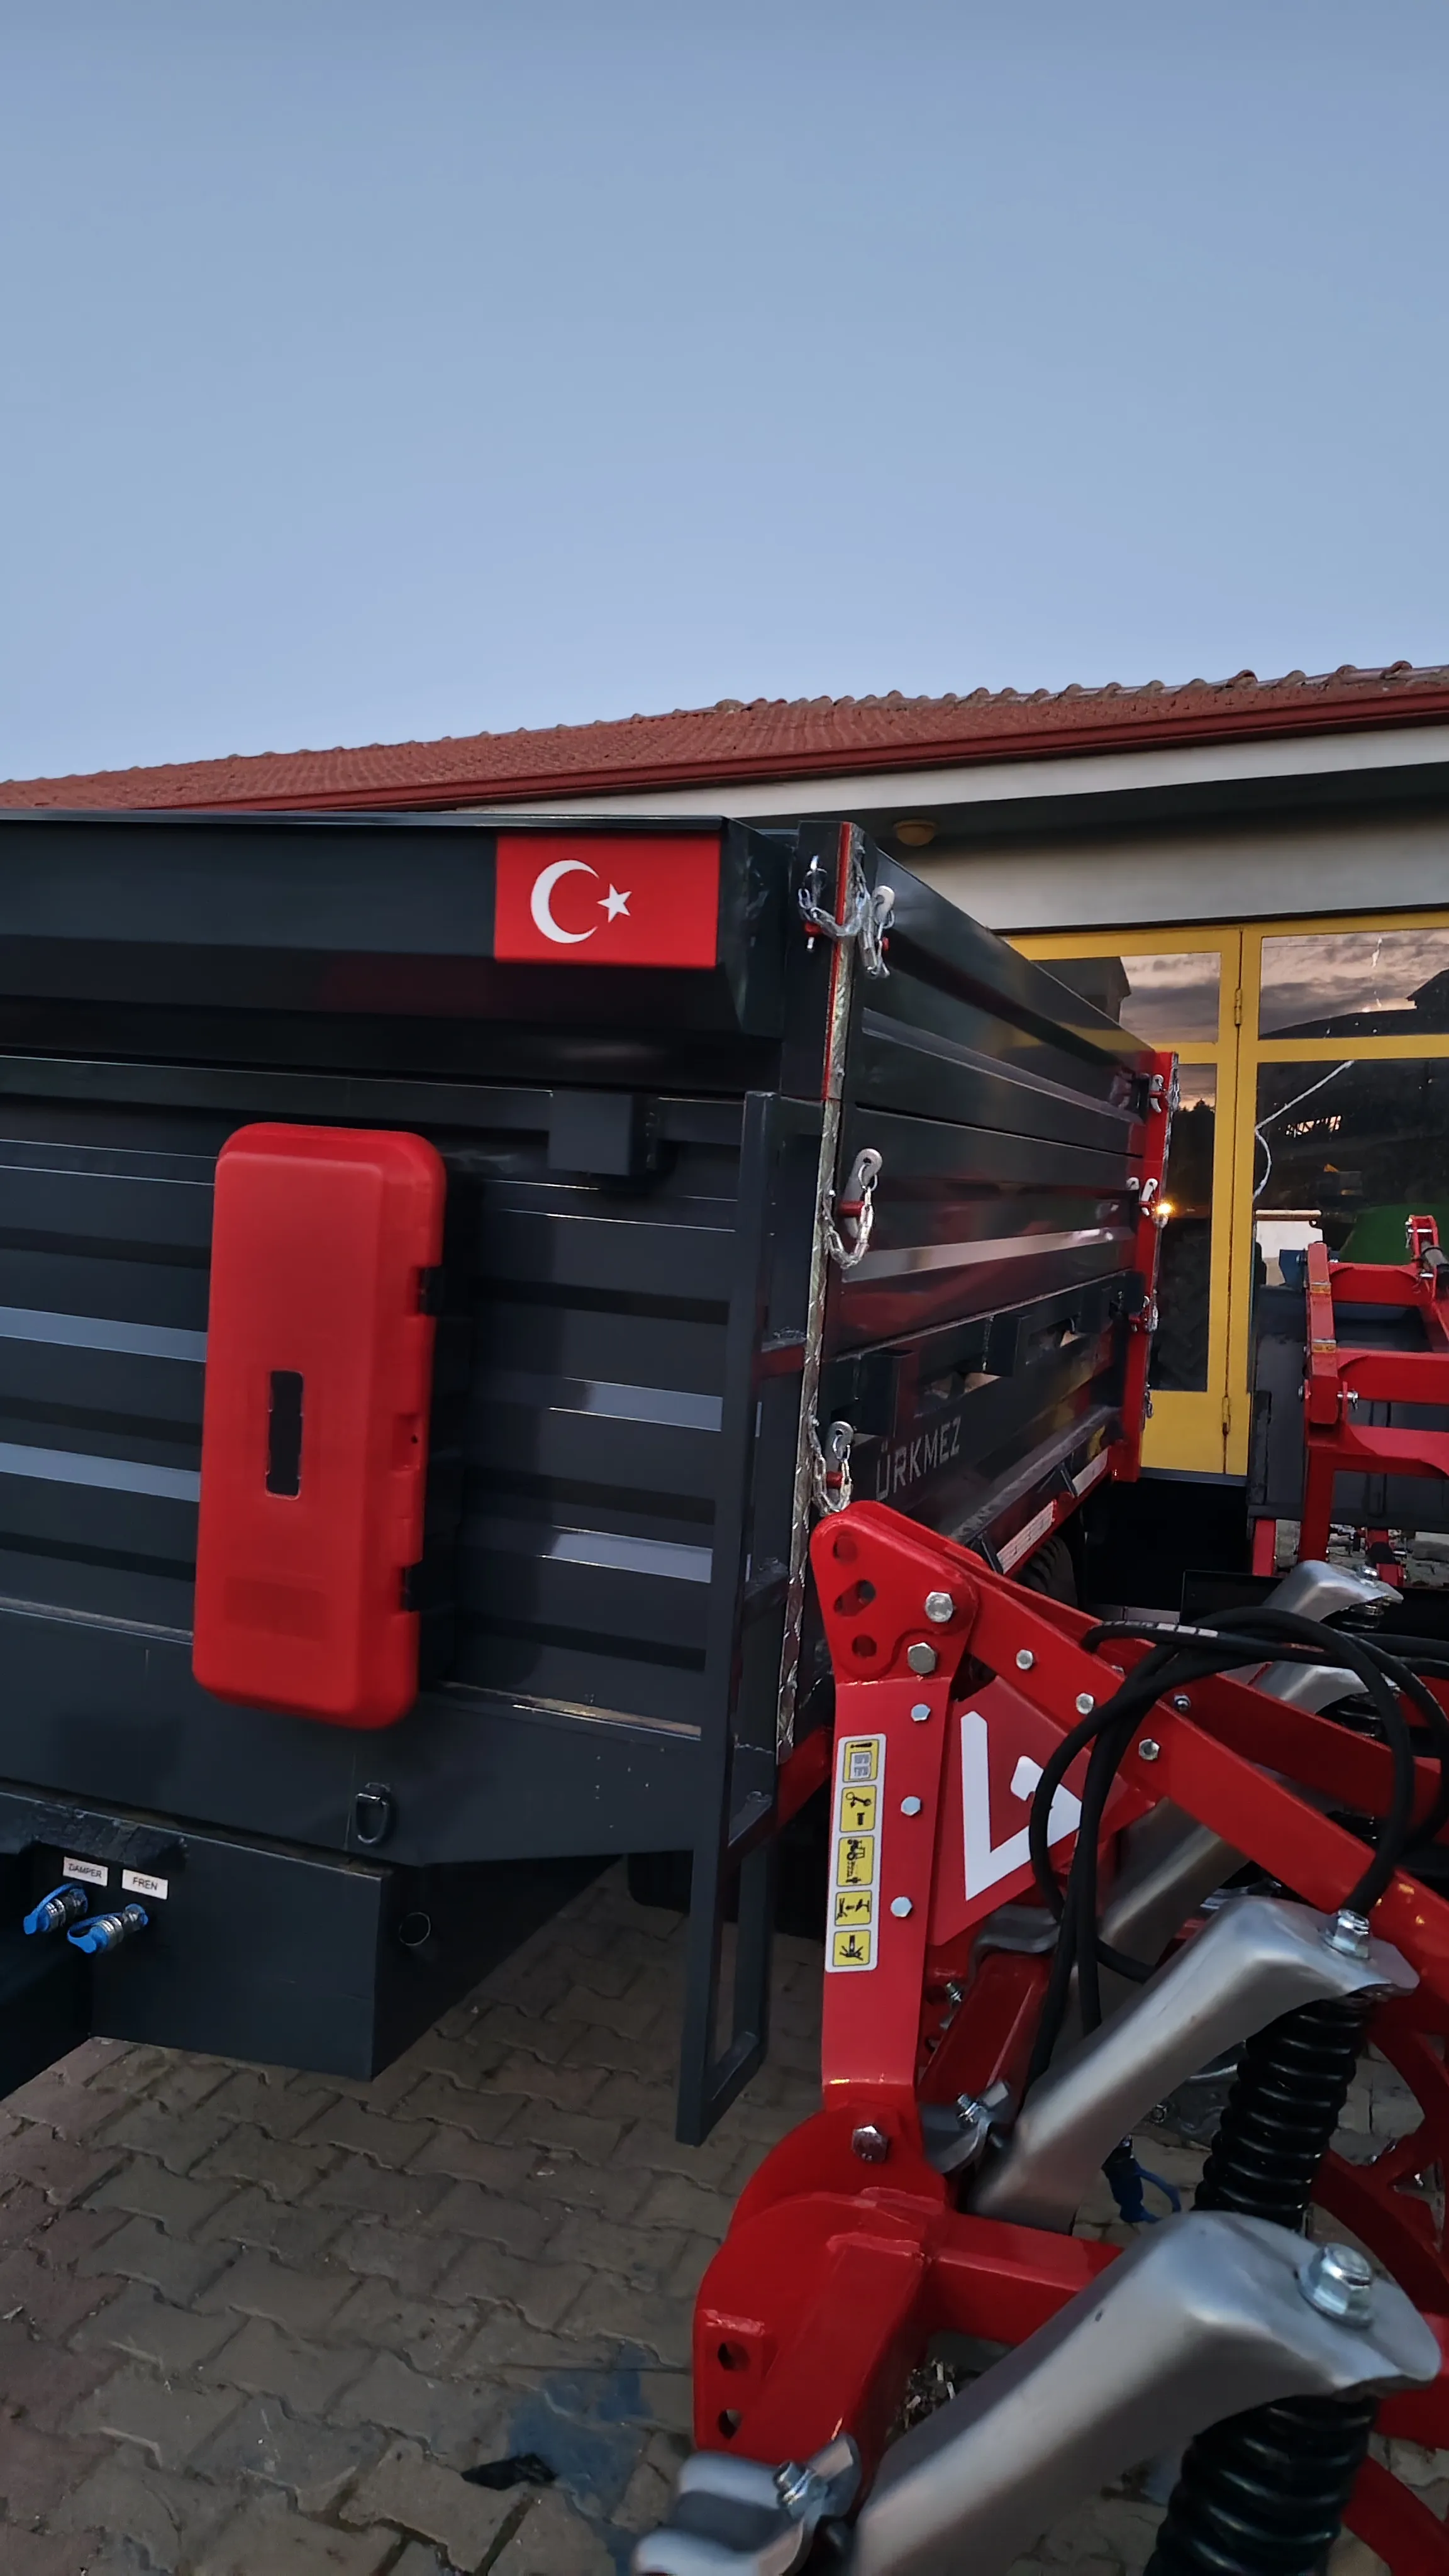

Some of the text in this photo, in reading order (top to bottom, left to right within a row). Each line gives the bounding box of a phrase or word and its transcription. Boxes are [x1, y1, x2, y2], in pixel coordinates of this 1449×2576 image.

[875, 1415, 962, 1501] ÜRKMEZ
[68, 1863, 102, 1878] DAMPER
[132, 1876, 158, 1890] FREN
